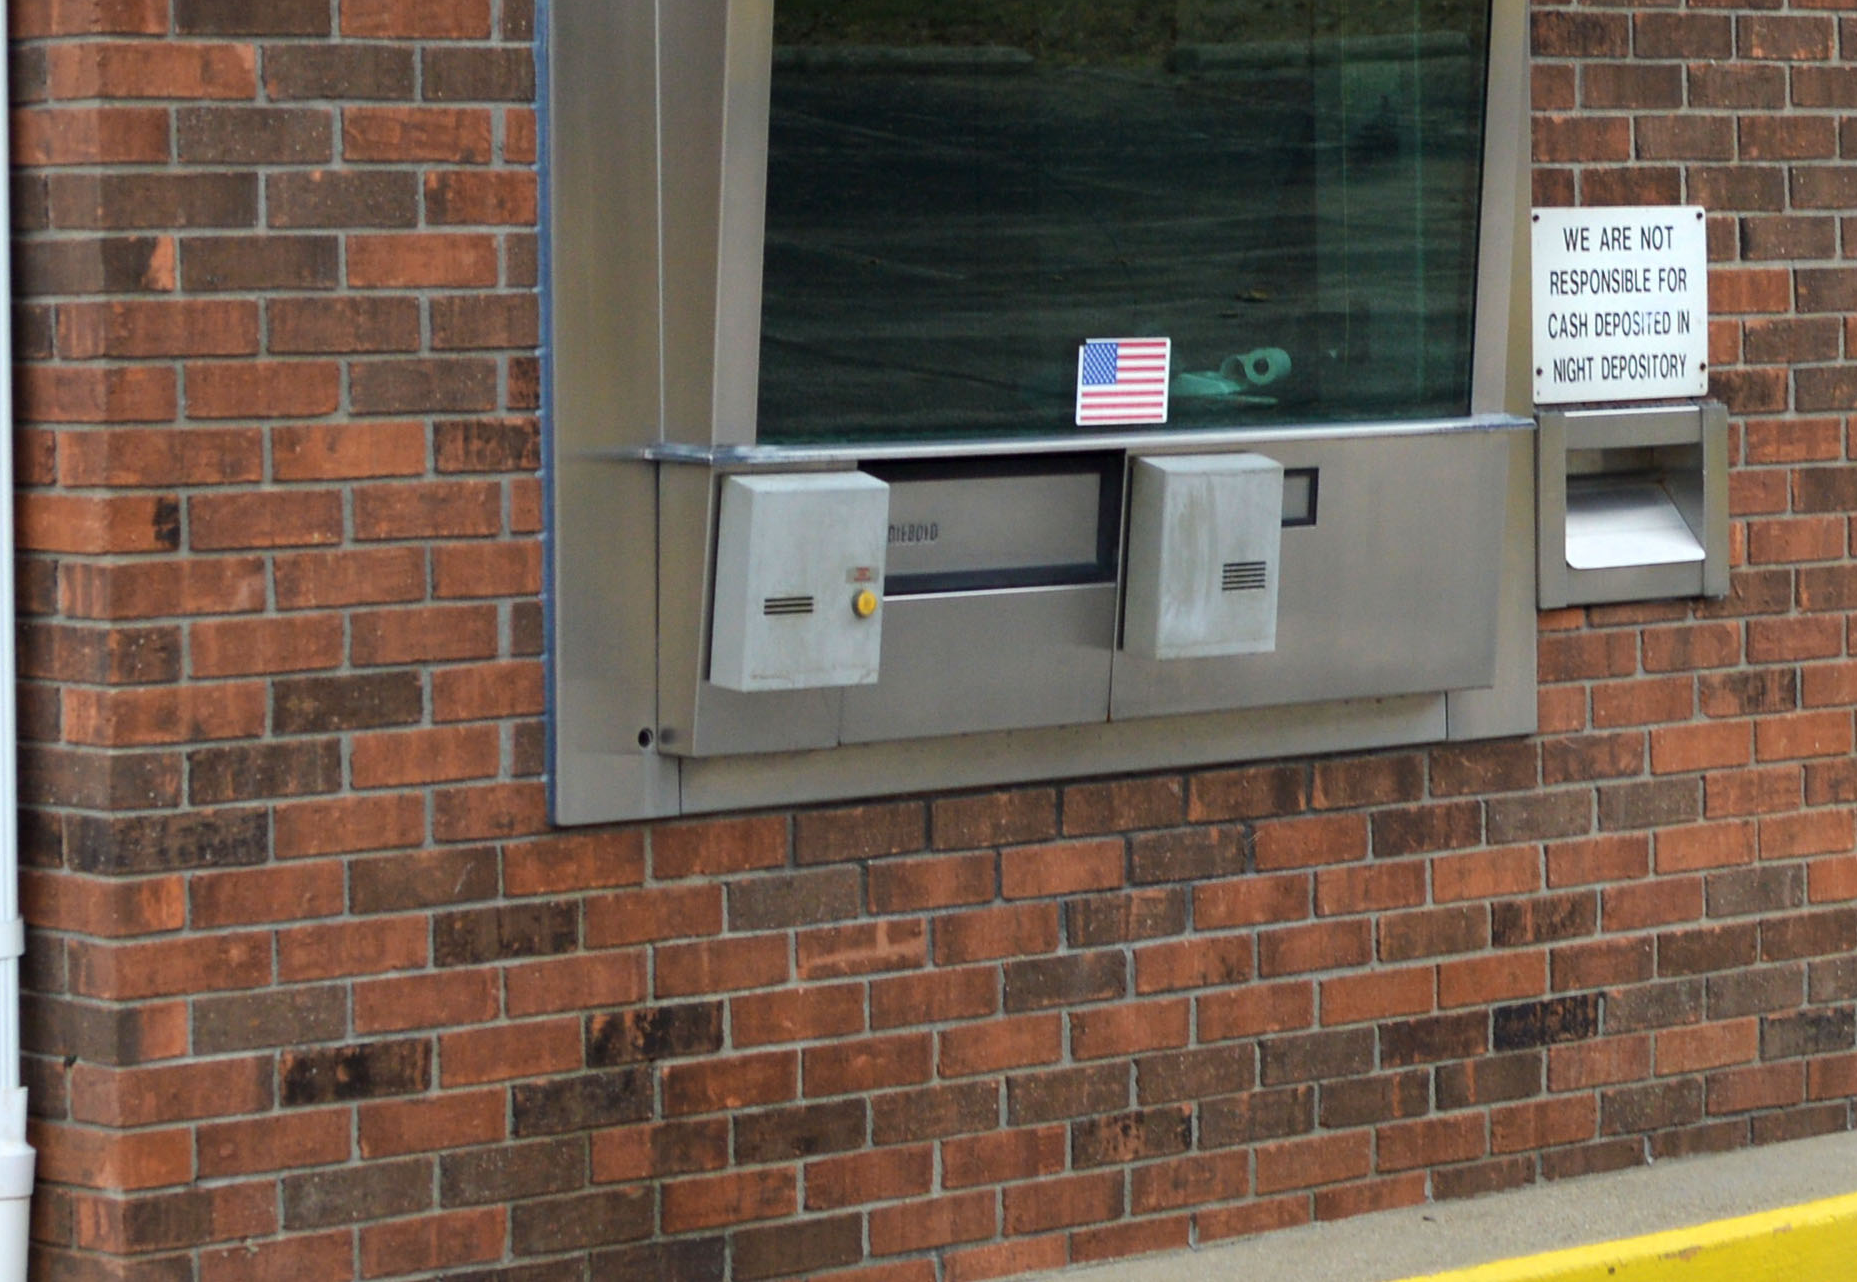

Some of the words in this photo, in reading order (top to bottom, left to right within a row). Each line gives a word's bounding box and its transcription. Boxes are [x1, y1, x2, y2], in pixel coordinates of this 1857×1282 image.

[1563, 226, 1590, 252] WE
[1600, 226, 1632, 252] ARE
[1640, 225, 1674, 251] NOT
[1550, 268, 1651, 296] RESPONSIBLE
[1658, 268, 1687, 293] FOR
[1548, 313, 1588, 339] CASH
[1594, 310, 1672, 337] DEPOSITED
[1677, 310, 1690, 334] IN
[1553, 357, 1594, 383] NIGHT
[1601, 354, 1687, 380] DEPOSITORY
